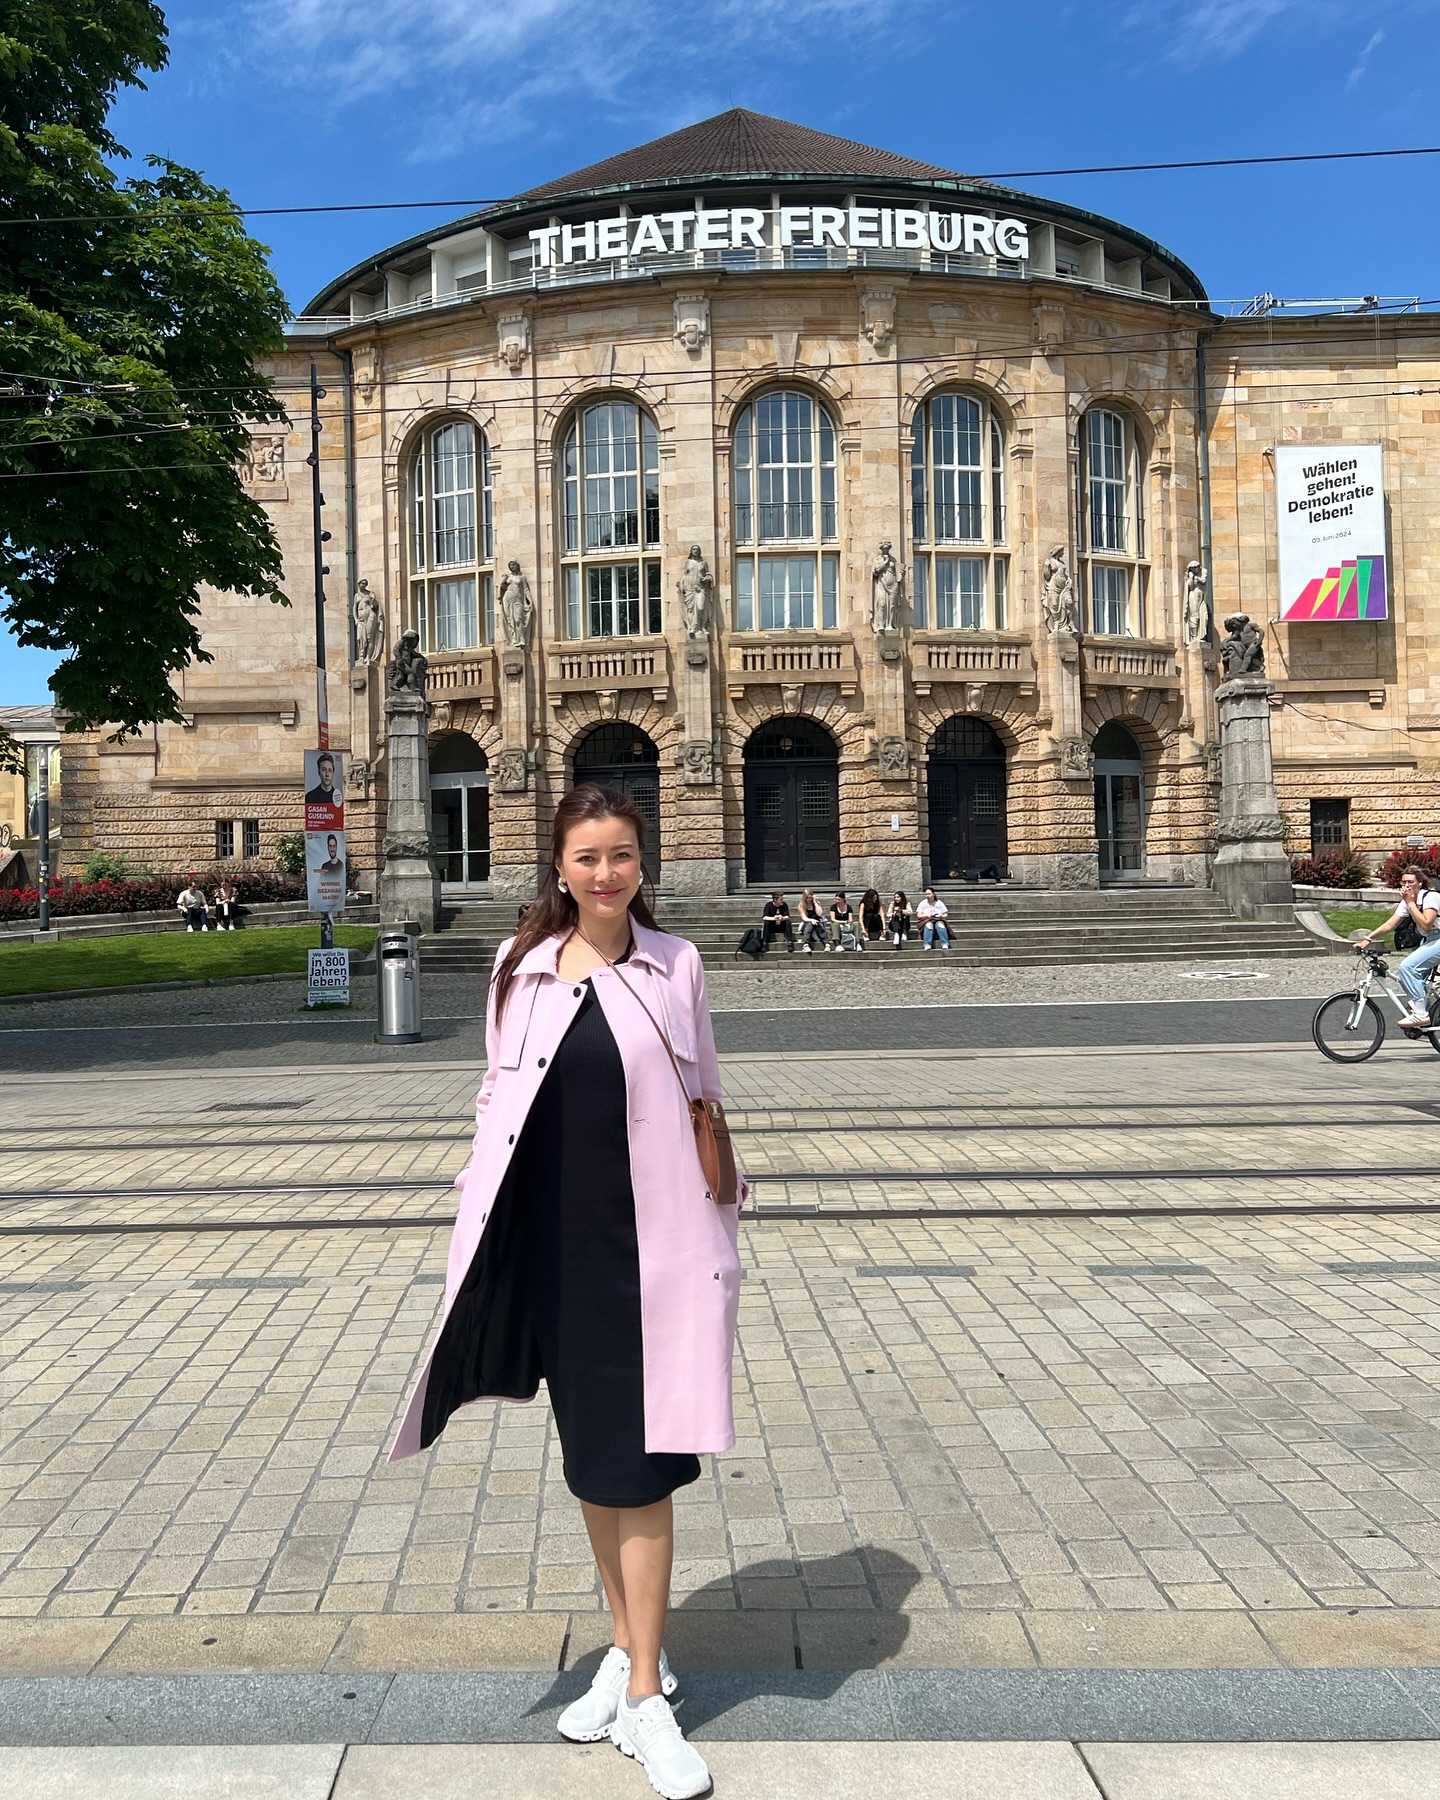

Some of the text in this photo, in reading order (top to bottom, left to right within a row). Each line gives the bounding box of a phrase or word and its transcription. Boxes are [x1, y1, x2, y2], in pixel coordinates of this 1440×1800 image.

[529, 206, 1029, 268] THEATER FREIBURG
[1302, 459, 1357, 479] Wählen
[1307, 473, 1356, 496] gehen!
[1288, 485, 1374, 513] Demokratie
[1308, 503, 1353, 523] leben!
[1335, 530, 1352, 539] 2024
[310, 966, 346, 976] Jahren
[312, 956, 346, 967] in 800
[310, 976, 346, 986] leben?
